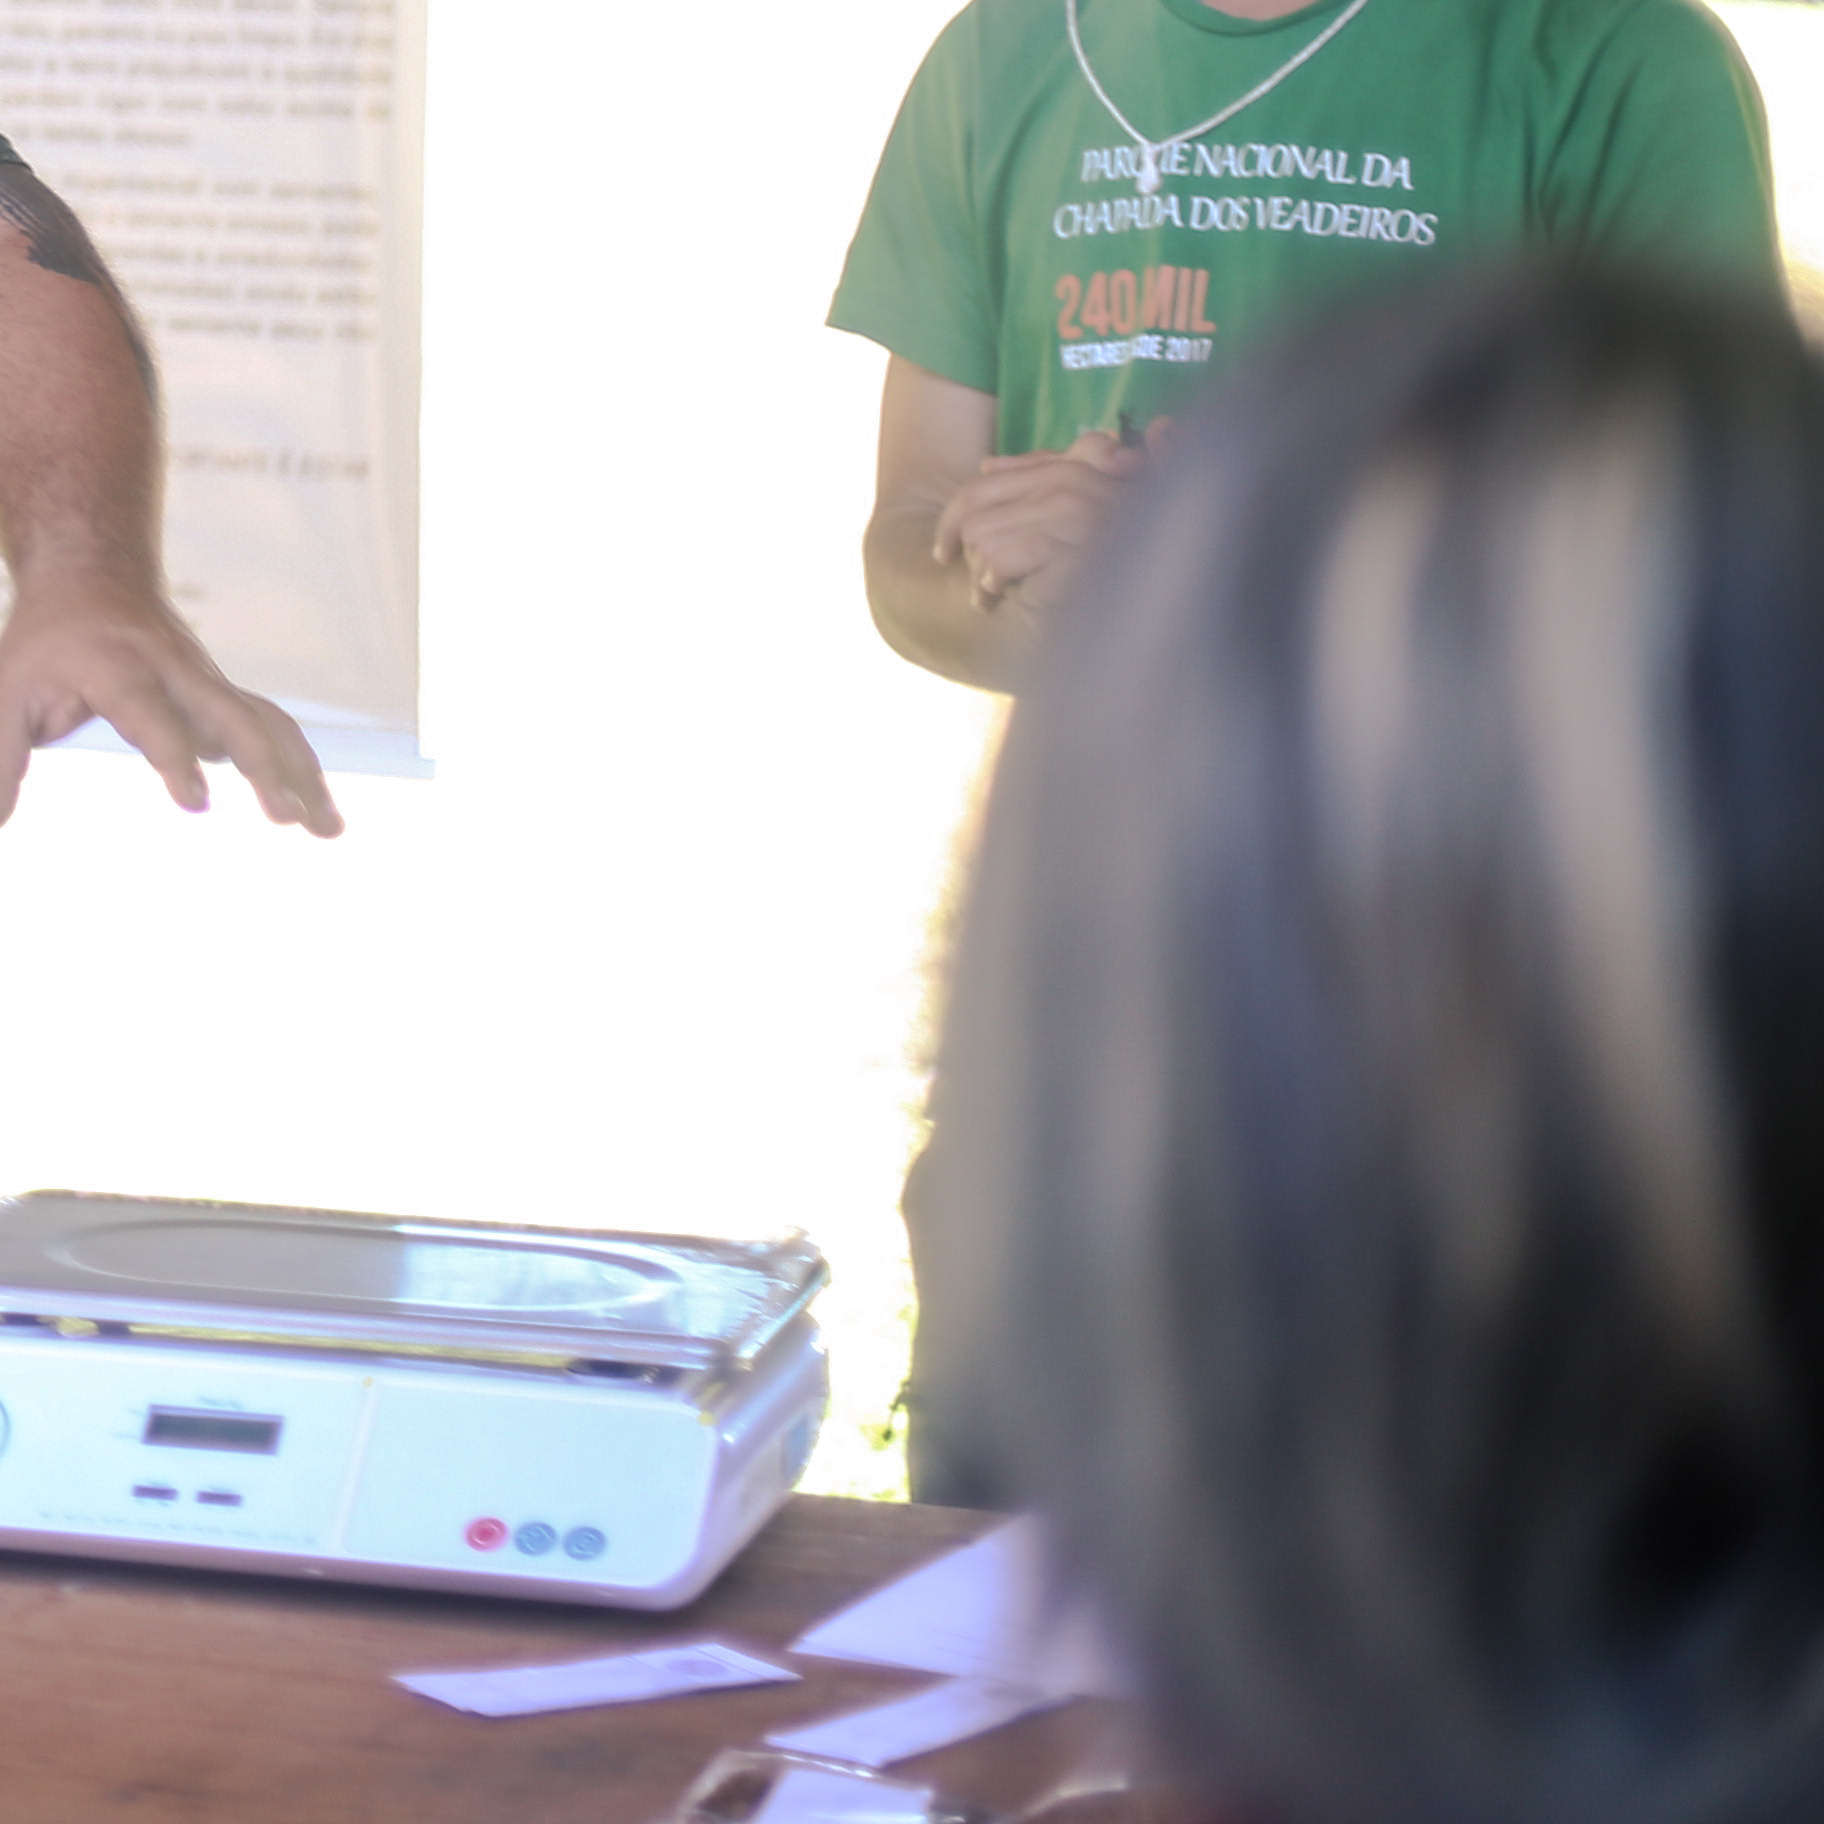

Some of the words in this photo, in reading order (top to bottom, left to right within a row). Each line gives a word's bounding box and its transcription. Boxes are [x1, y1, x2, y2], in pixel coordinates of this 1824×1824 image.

[1192, 143, 1357, 185] NACIONAL
[1361, 152, 1415, 191] DA
[1053, 194, 1184, 239] CHAPADA
[1190, 196, 1250, 231] DOS
[1253, 196, 1439, 246] VEADEIROS
[1056, 269, 1137, 340] 240
[1142, 264, 1216, 333] MIL
[1164, 336, 1213, 362] 2017
